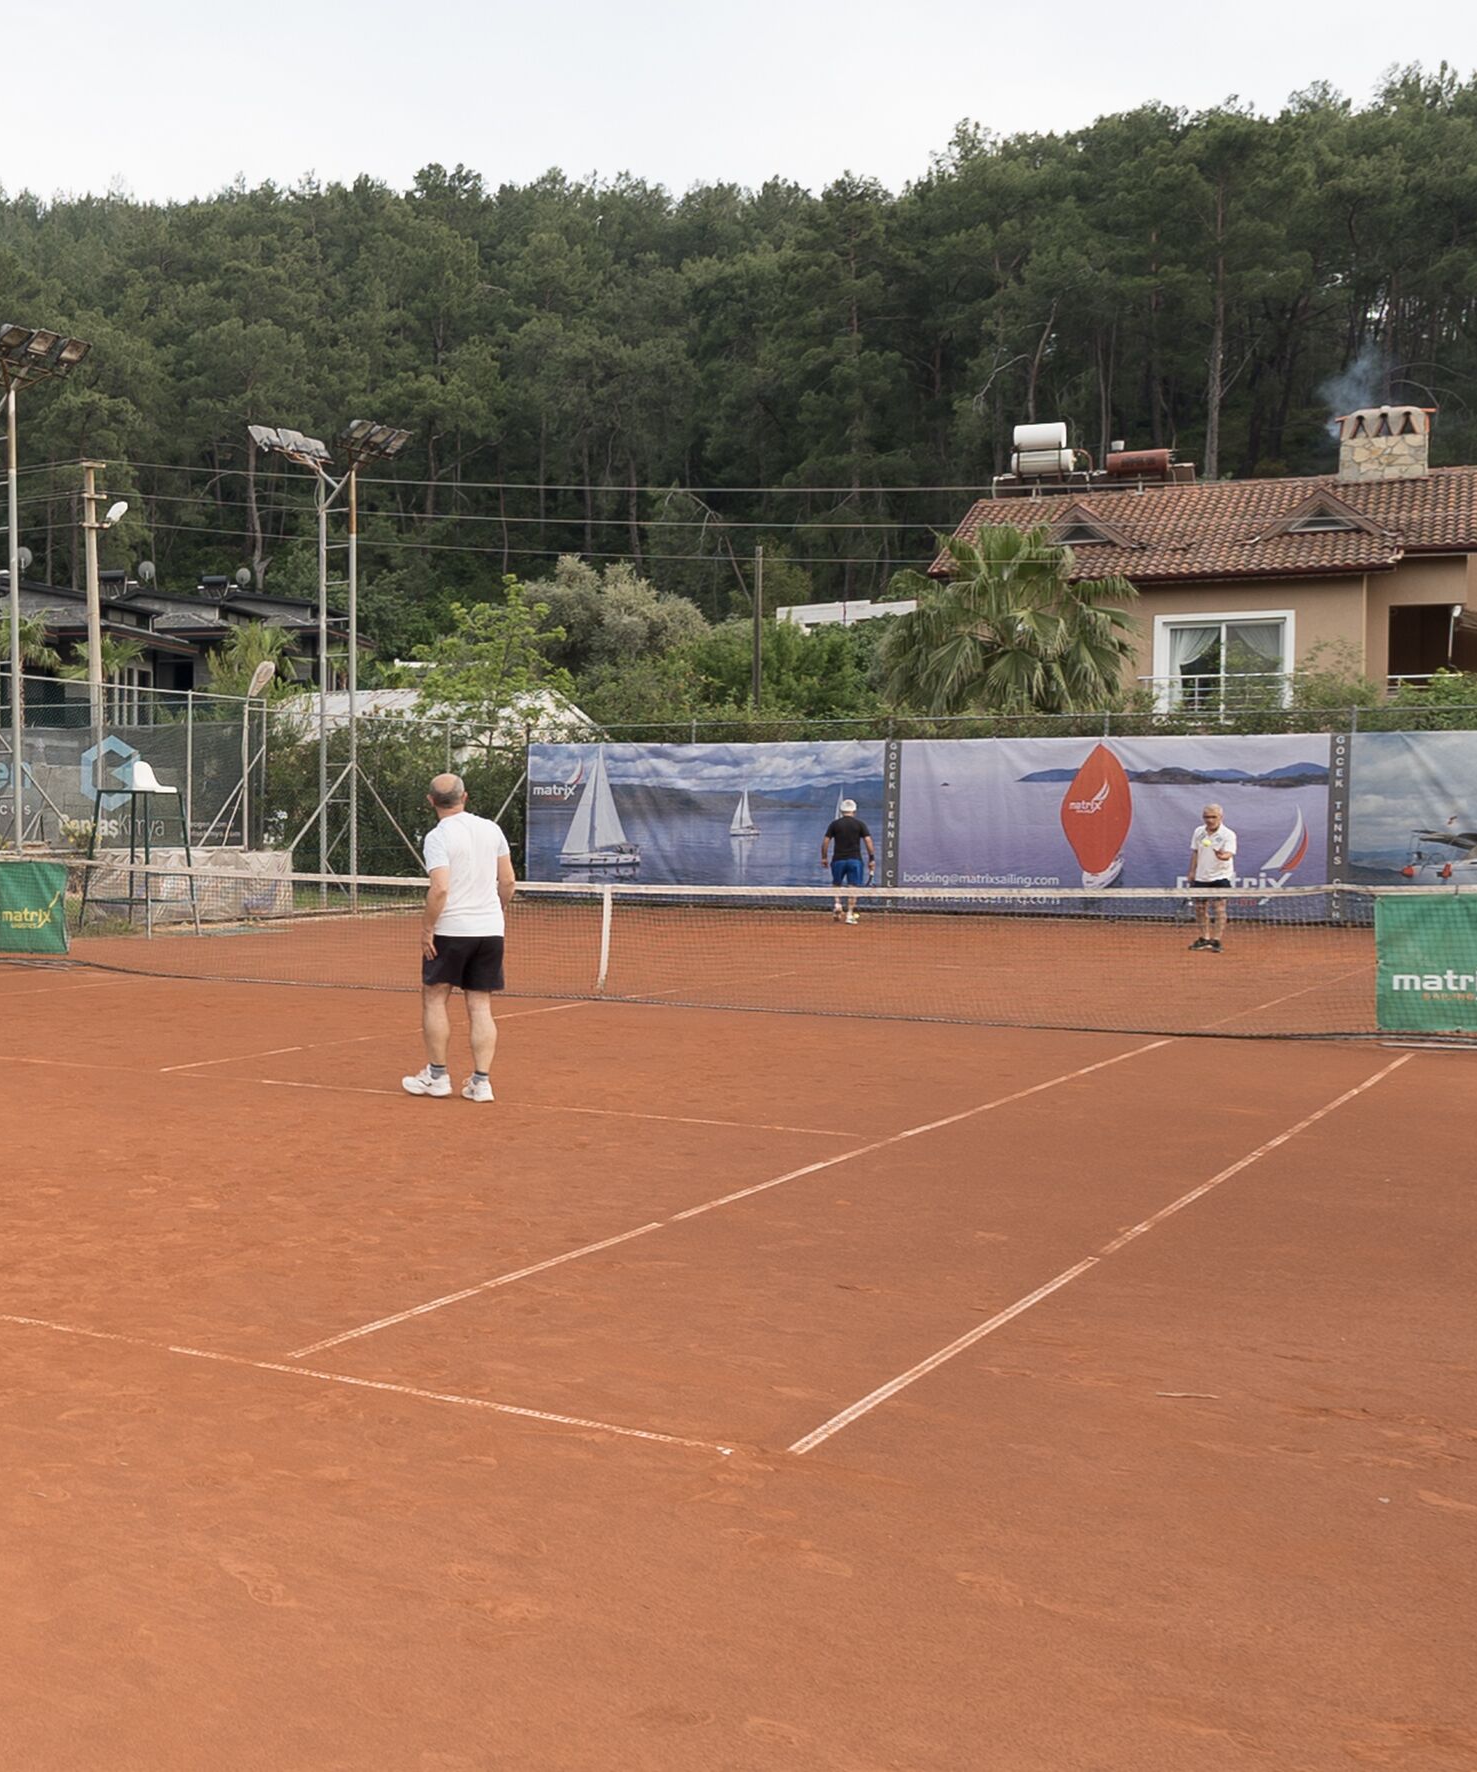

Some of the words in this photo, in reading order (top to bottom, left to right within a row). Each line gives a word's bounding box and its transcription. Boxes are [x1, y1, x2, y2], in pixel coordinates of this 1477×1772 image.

[532, 783, 578, 801] matrix
[886, 801, 897, 859] TENNIS
[1332, 801, 1344, 866] TENNIS
[902, 872, 1060, 887] booking@matrixsailing.com
[1, 907, 52, 929] matrix
[1391, 969, 1477, 992] matr
